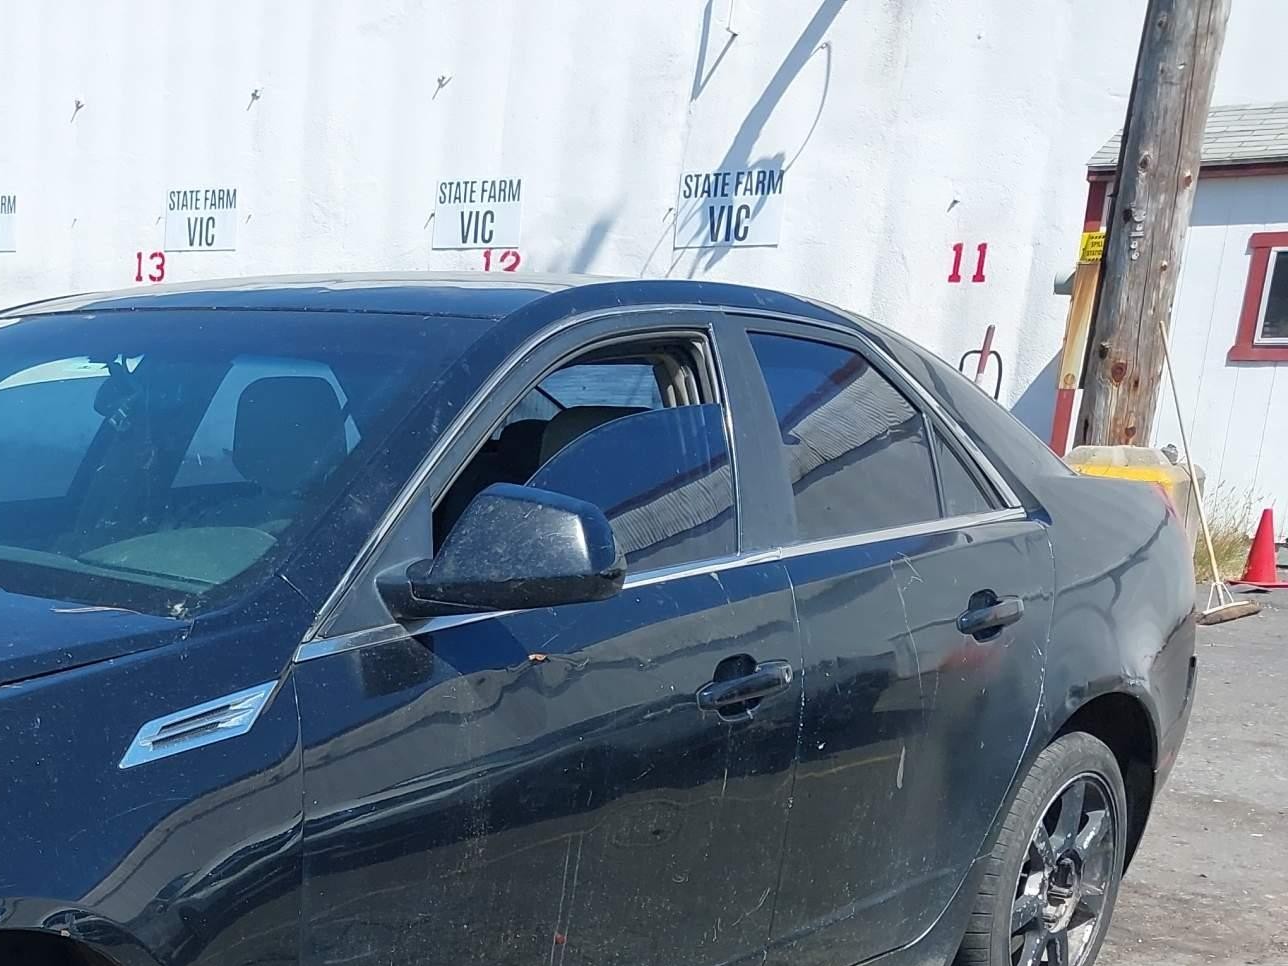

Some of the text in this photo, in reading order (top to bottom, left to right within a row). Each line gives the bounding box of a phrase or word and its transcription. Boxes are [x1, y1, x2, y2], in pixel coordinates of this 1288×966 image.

[168, 188, 238, 212] STATE FARM
[438, 179, 522, 205] STATE FARM
[682, 169, 785, 200] STATE FARM
[186, 216, 216, 248] VIC
[460, 210, 495, 245] VIC
[708, 204, 751, 243] VIC
[135, 252, 166, 282] 13
[483, 250, 521, 272] 12
[947, 242, 988, 283] 11
